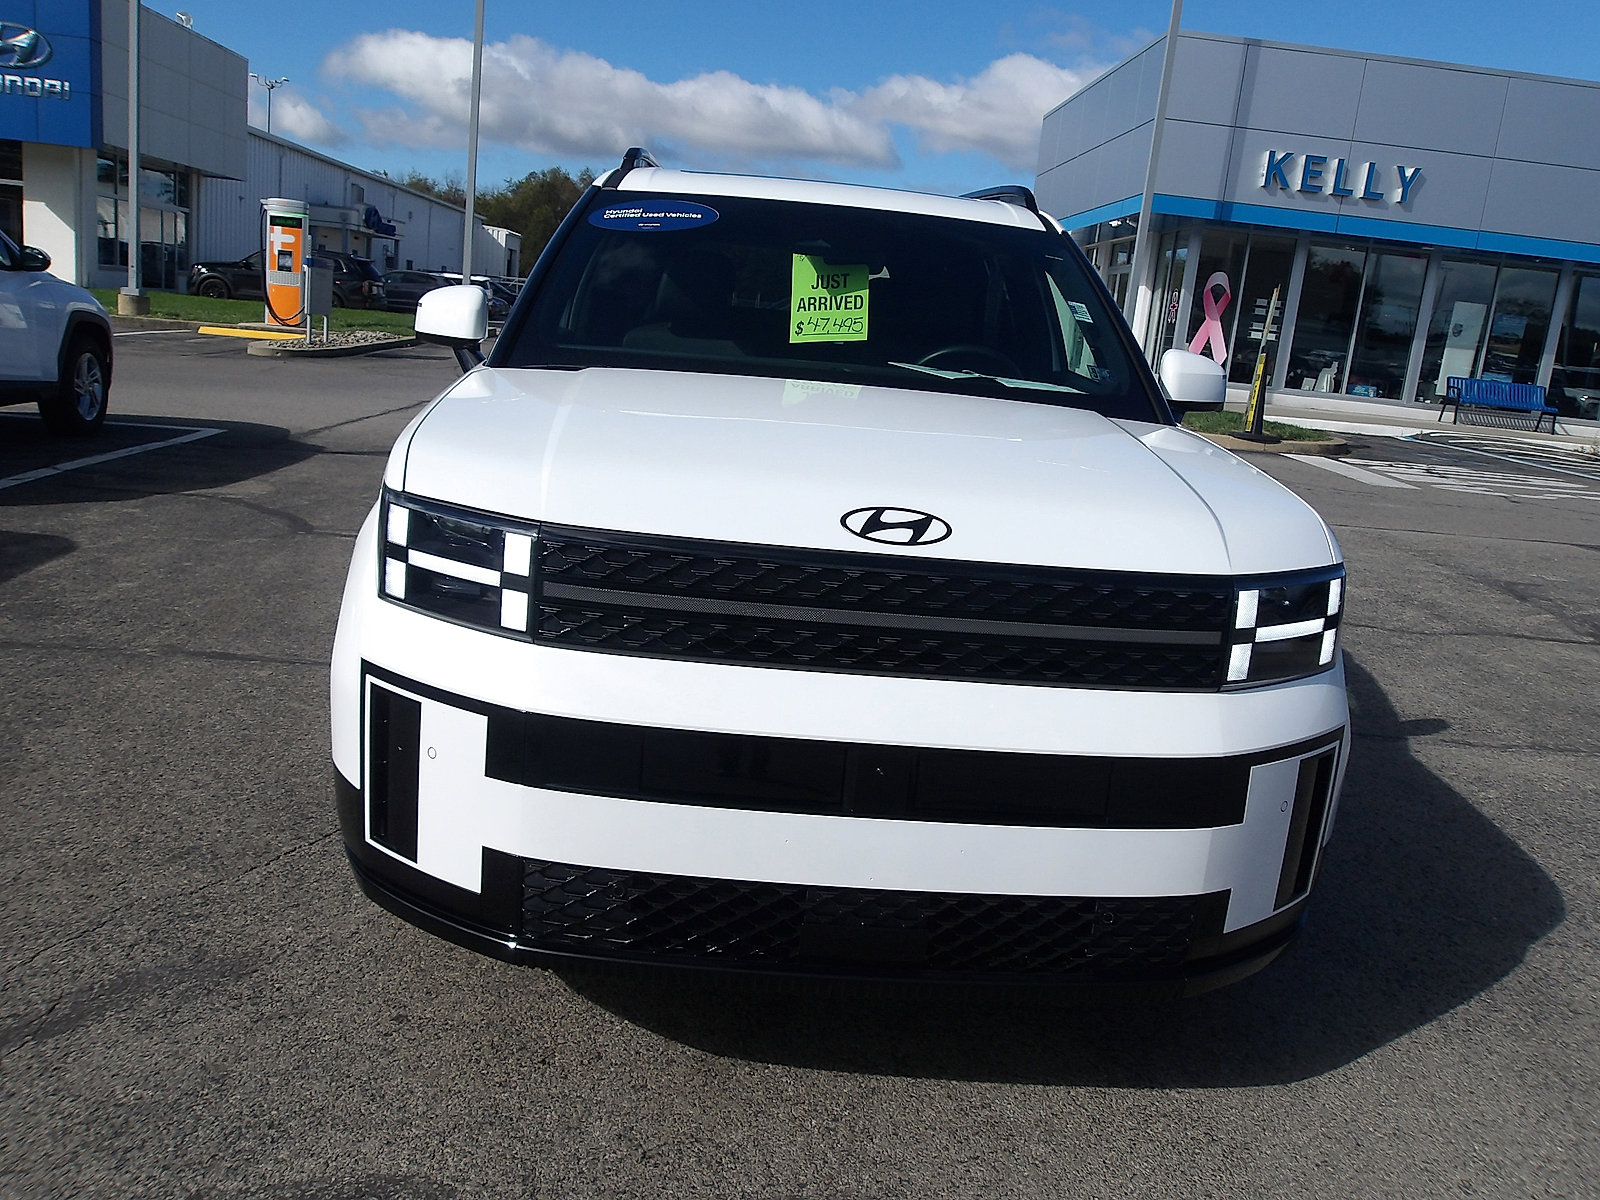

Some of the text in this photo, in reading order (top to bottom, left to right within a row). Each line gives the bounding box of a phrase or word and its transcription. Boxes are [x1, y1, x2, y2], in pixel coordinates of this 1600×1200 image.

[1261, 149, 1423, 204] KELLY
[811, 273, 850, 290] JUST
[796, 294, 864, 313] ARRIVED
